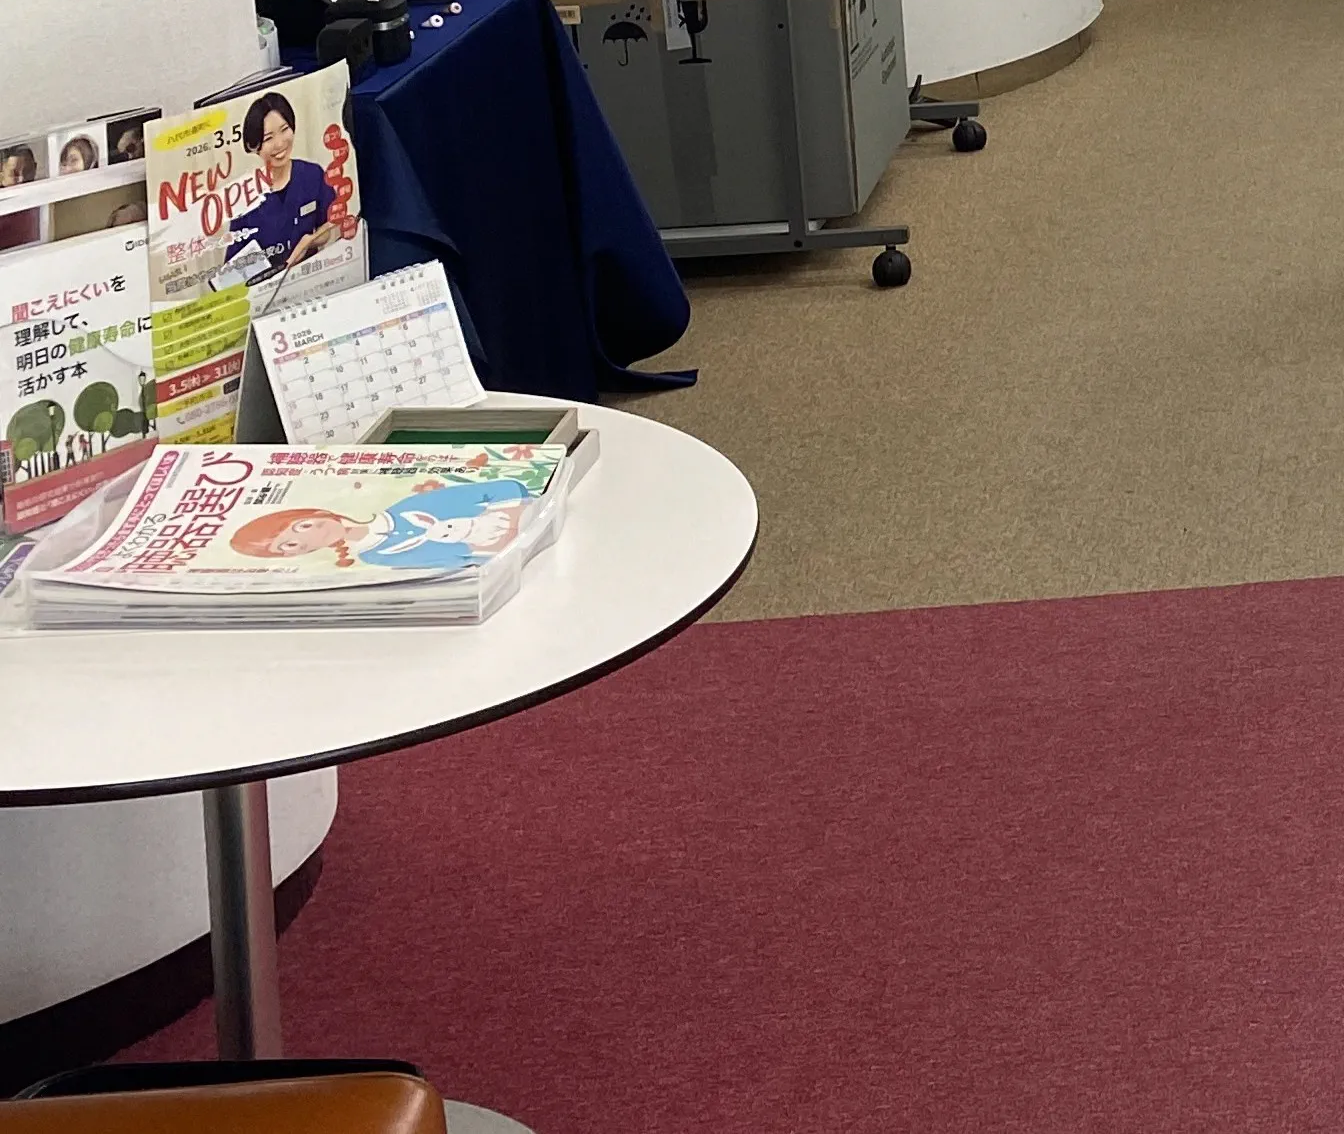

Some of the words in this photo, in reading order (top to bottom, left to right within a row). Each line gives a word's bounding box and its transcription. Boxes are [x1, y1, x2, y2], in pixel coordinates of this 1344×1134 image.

[213, 124, 243, 149] 3.5
[158, 151, 233, 220] NEW
[200, 161, 275, 237] OPEN
[12, 275, 126, 324] 聞こえにくいを
[14, 313, 88, 348] 理解して、
[16, 315, 152, 372] 明日の健康寿命に
[271, 330, 288, 353] 3
[294, 333, 324, 348] MARCH
[330, 348, 335, 356] 3
[18, 361, 88, 399] 活かす本
[309, 375, 314, 383] 9
